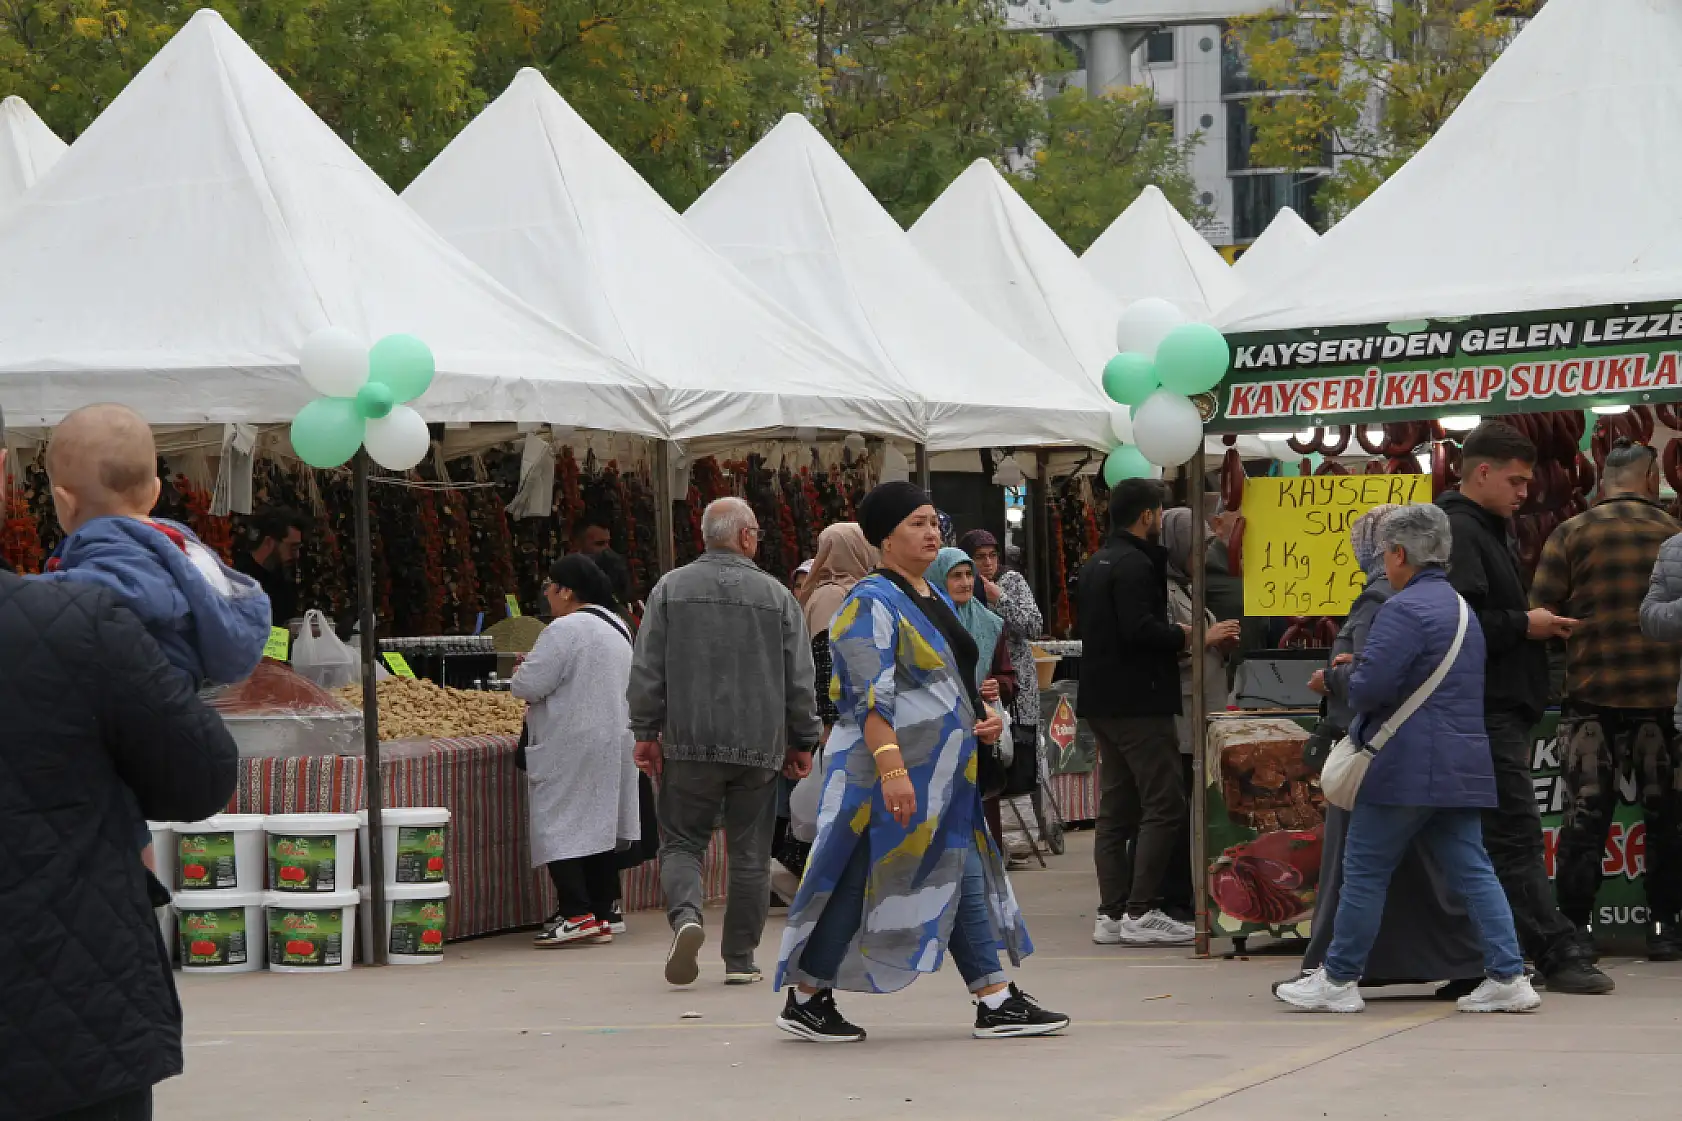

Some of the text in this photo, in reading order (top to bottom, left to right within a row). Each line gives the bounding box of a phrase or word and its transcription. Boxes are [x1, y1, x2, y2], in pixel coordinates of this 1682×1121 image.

[1461, 321, 1575, 352] GELEN
[1226, 367, 1381, 417] KAYSERİ
[1381, 367, 1504, 407] KASAP
[1303, 509, 1360, 536] SUC
[1332, 539, 1349, 566] 6
[1600, 906, 1652, 924] SUC
